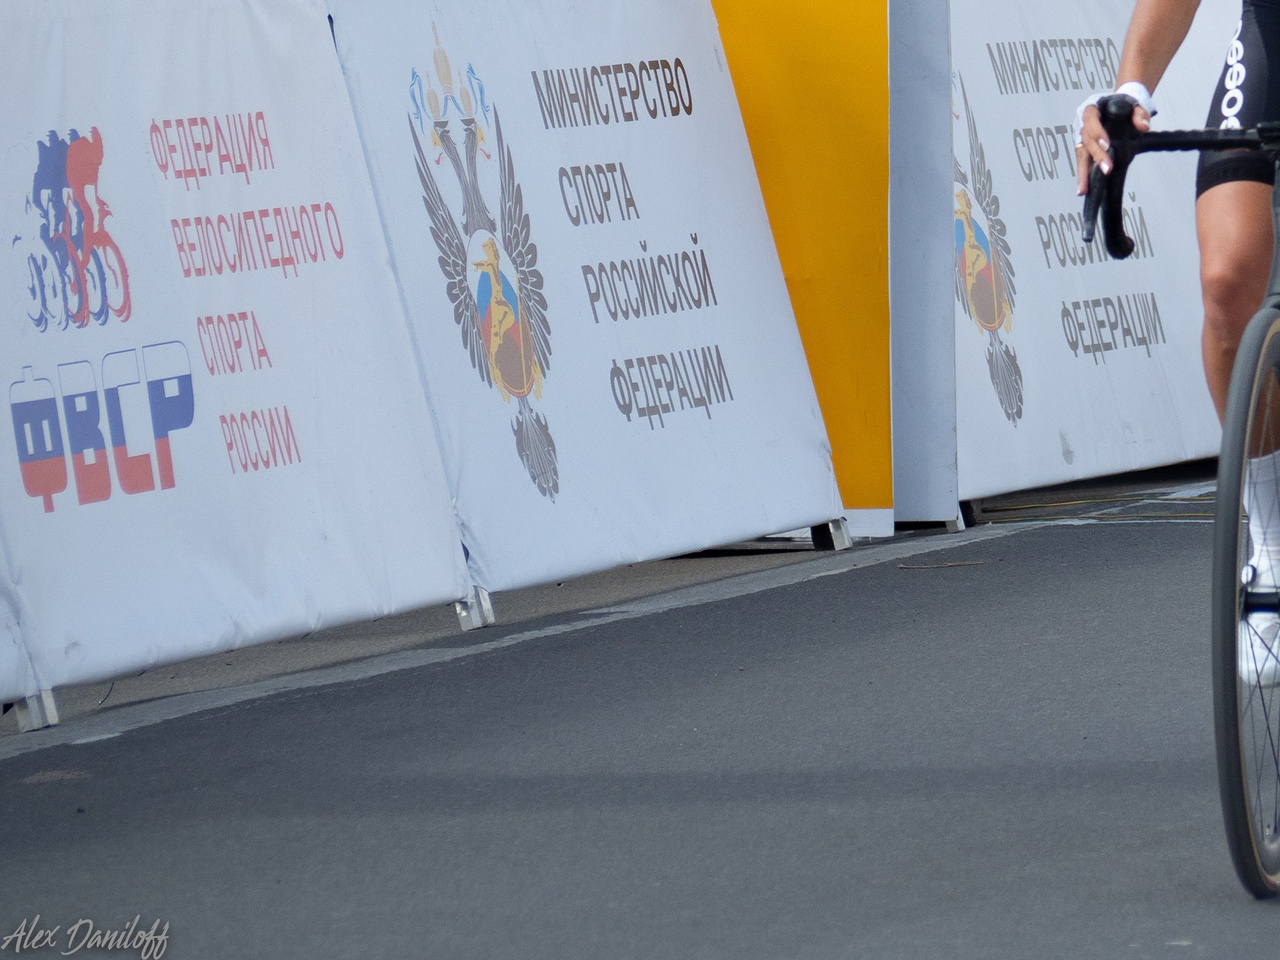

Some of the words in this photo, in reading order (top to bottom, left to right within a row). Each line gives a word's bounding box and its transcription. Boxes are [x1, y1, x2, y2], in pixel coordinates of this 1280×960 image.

[531, 57, 694, 129] МИНИСТЕРСТВО
[149, 111, 275, 191] ФЕДЕРАЦИЯ
[1013, 124, 1076, 182] СПОРТ
[558, 162, 640, 227] СПОРТА
[170, 202, 345, 279] ВЕЛОСИПЕДНОГО
[581, 232, 718, 324] РОССИЙСКОЙ
[197, 310, 273, 376] СПОРТА
[1061, 292, 1166, 366] ФЕДЕРАЦИИ
[609, 344, 734, 430] ФЕДЕРАЦИИ
[219, 405, 302, 475] РОССИИ
